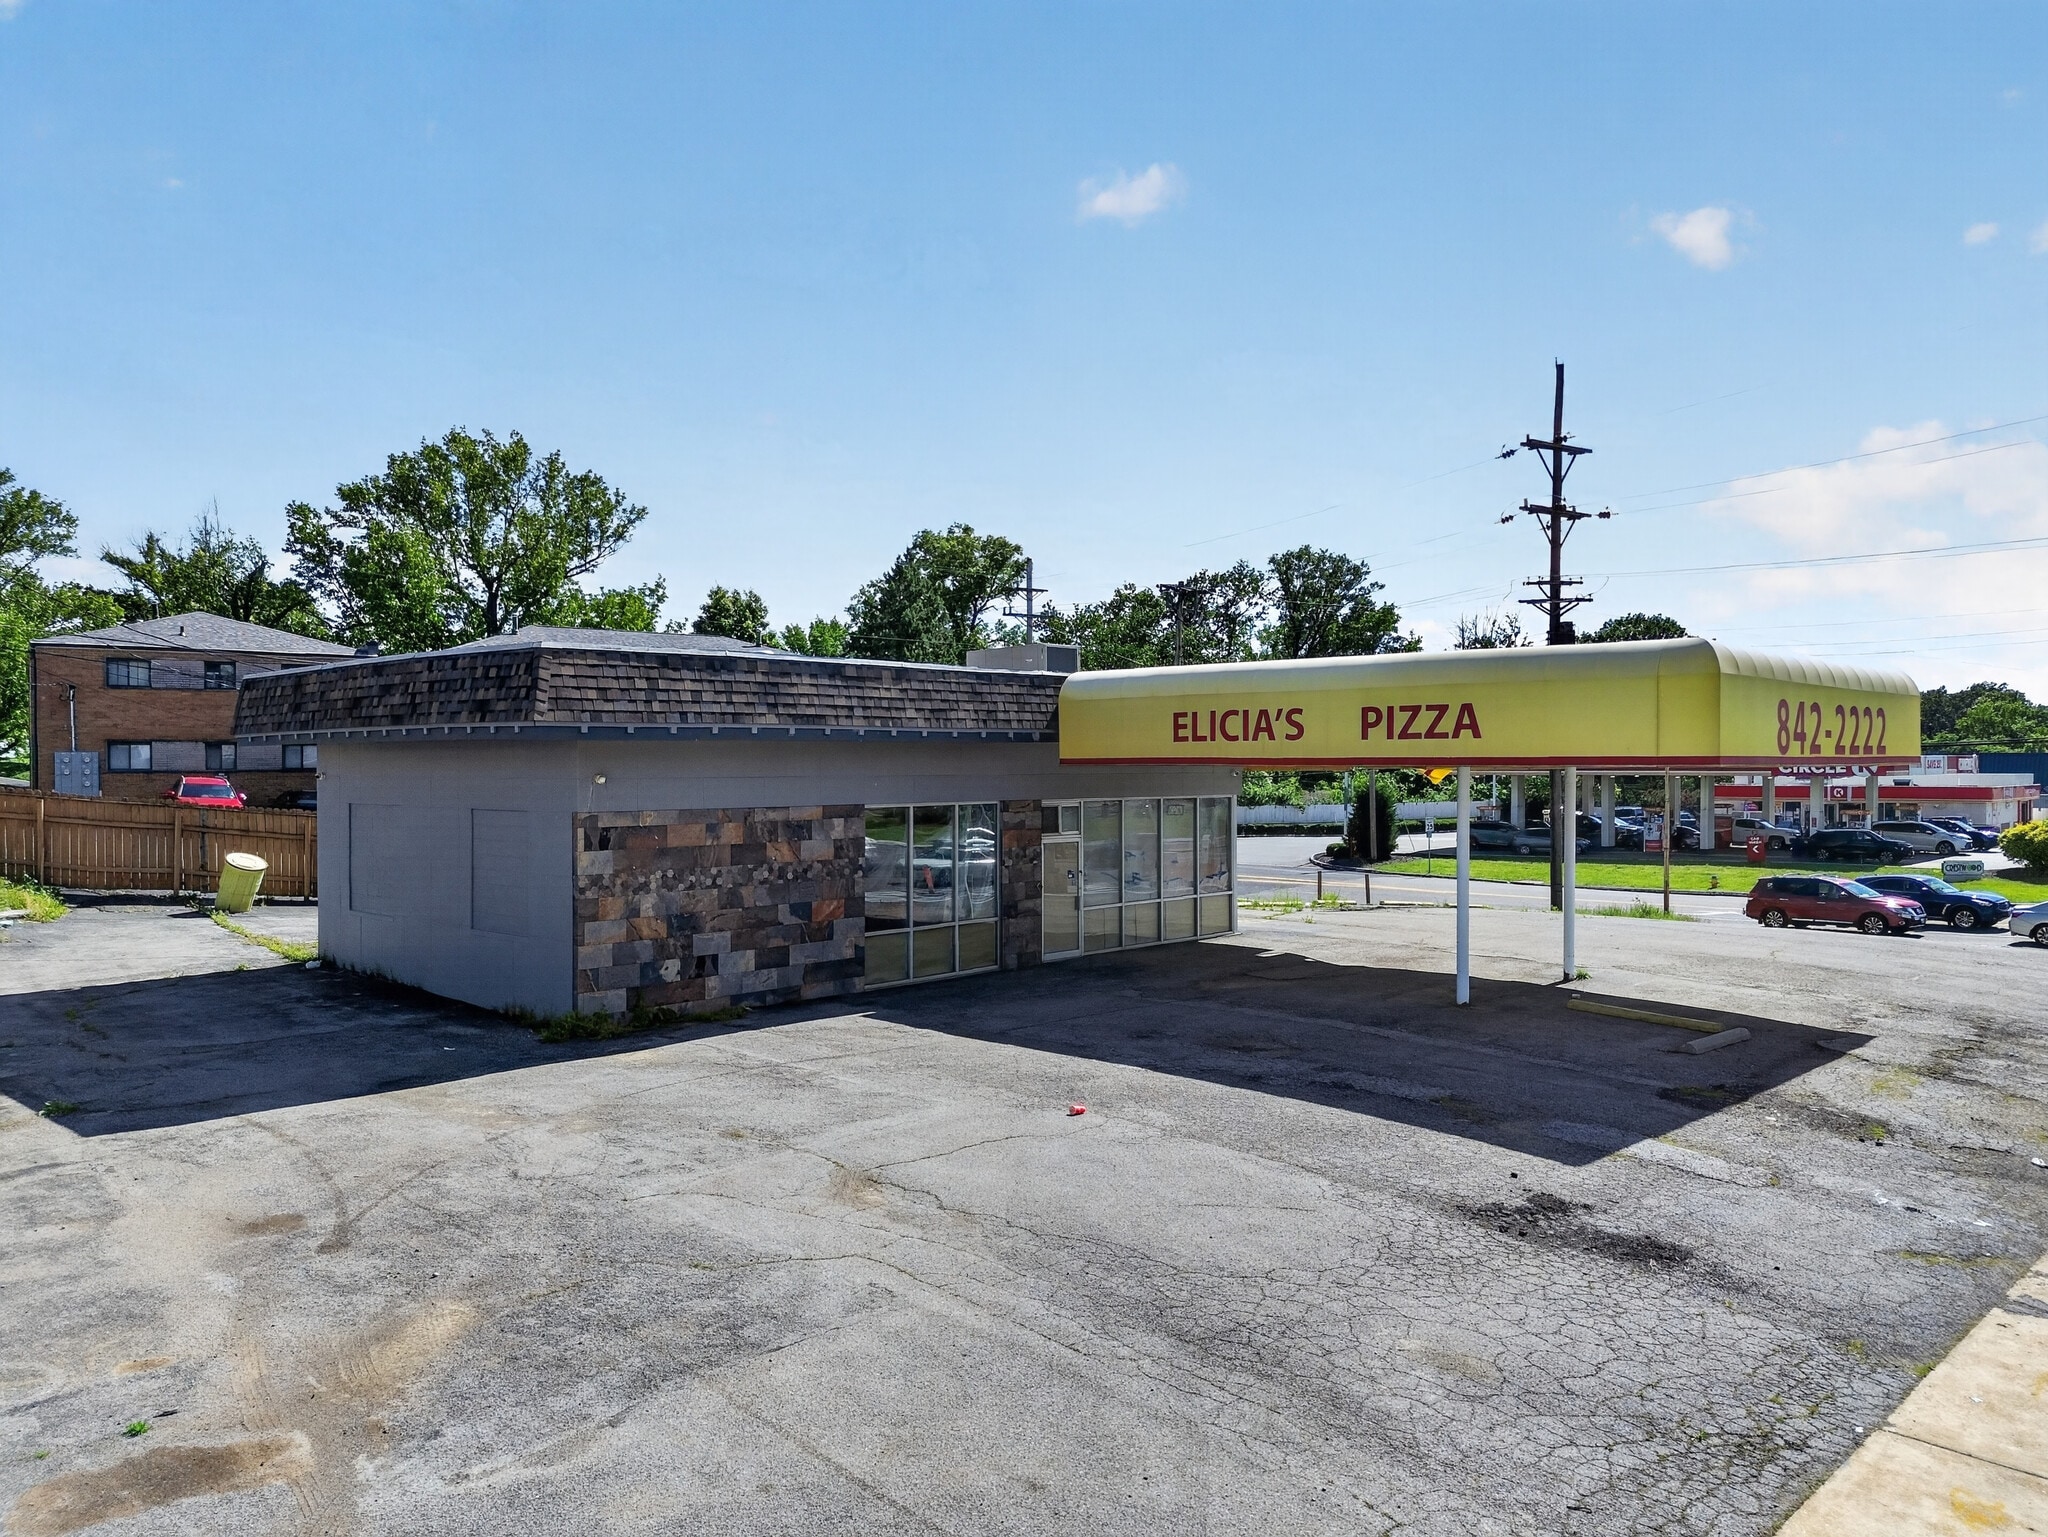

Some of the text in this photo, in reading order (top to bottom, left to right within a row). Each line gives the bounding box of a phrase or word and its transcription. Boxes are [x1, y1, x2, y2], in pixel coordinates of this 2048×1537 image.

[1172, 703, 1482, 743] ELICIA'S PIZZA
[1777, 699, 1886, 755] 842-2222
